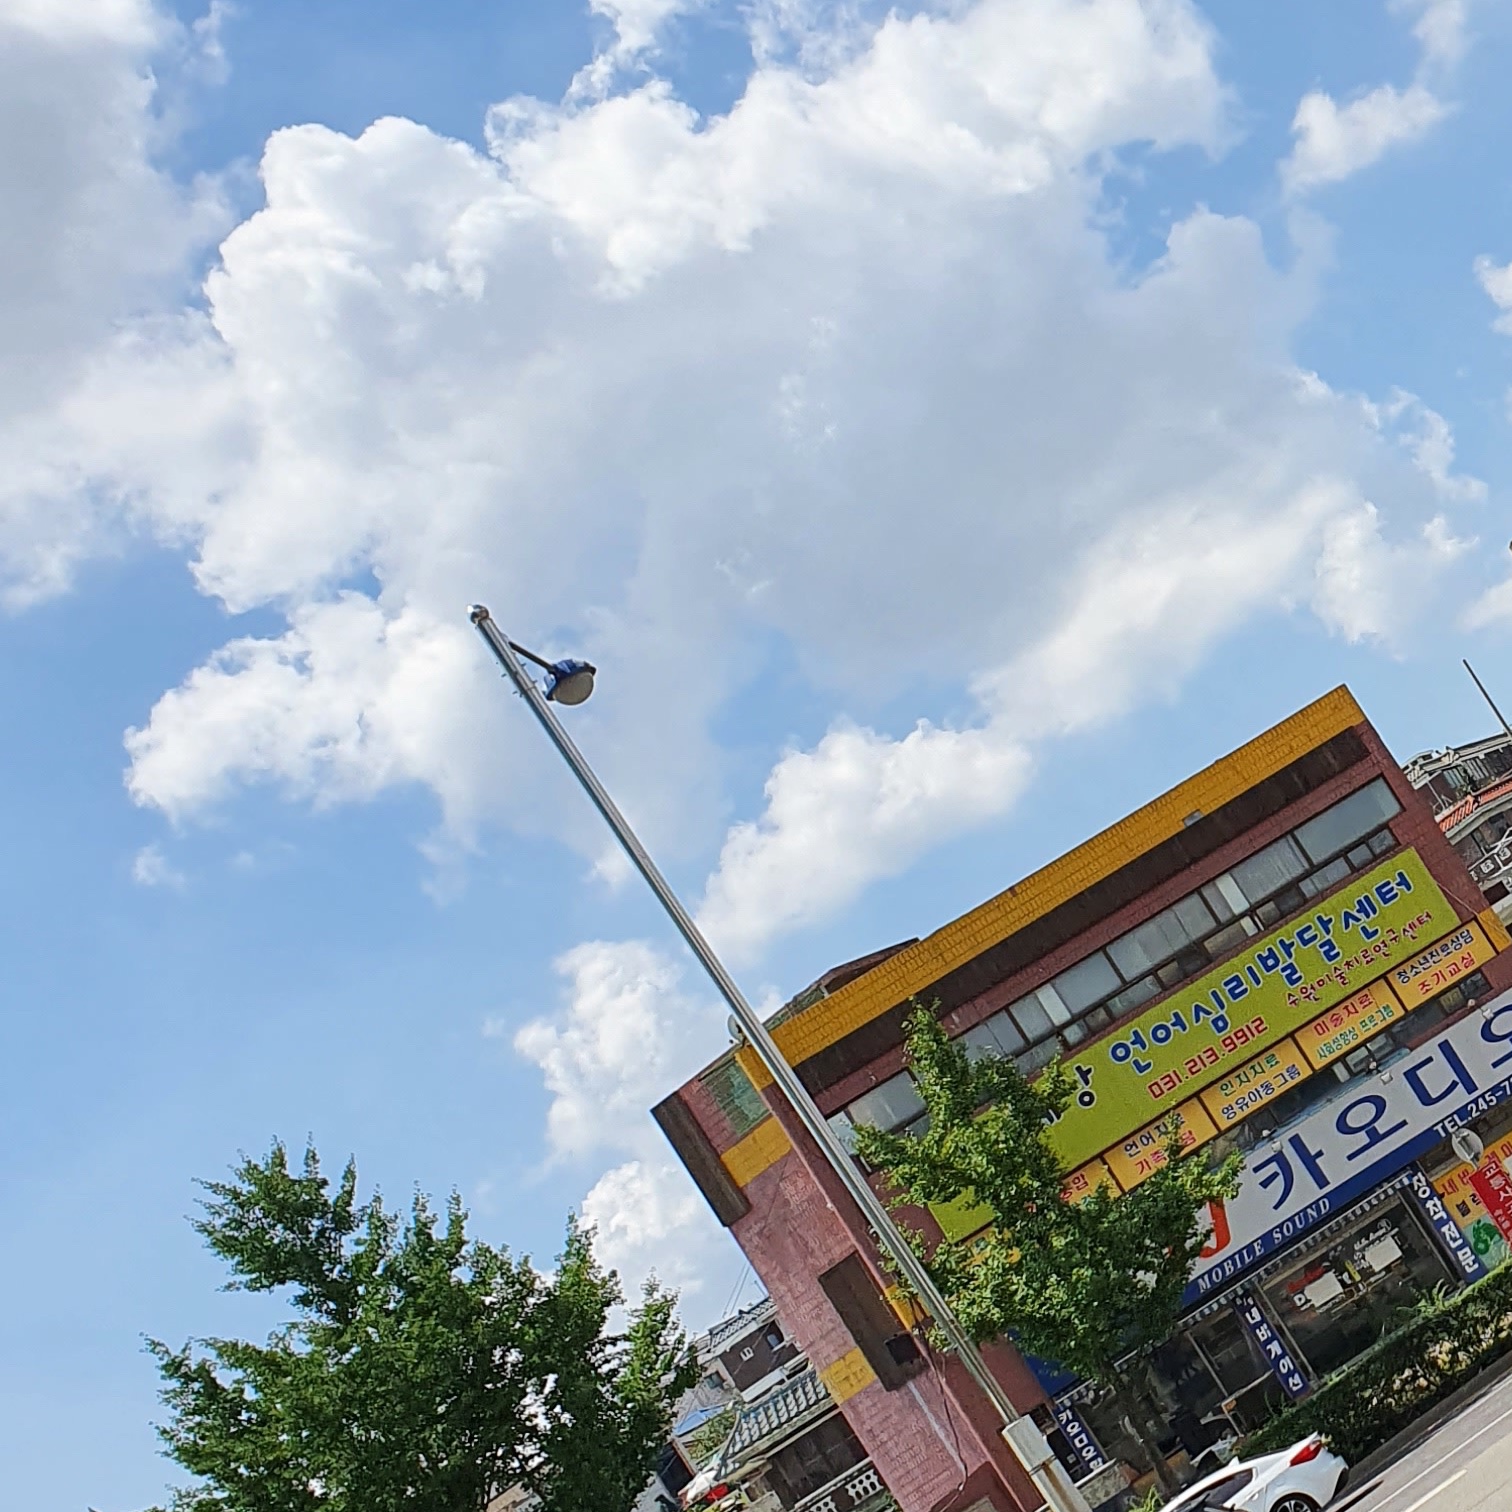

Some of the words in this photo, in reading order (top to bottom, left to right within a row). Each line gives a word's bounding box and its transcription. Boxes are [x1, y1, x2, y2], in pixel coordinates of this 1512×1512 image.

[1105, 865, 1427, 1087] 언어심리발달센터
[1395, 926, 1476, 986] 청소년진로상담
[1415, 950, 1476, 997] 조기교실
[1311, 991, 1375, 1039] 미술치료
[1145, 1014, 1270, 1100] 031.213.9912
[1218, 1050, 1280, 1098] 인지치료
[1219, 1061, 1304, 1123] 영유아동그룹
[1133, 1129, 1197, 1176] 가족담
[1193, 1237, 1267, 1295] MOBILE
[1268, 1194, 1334, 1245] SOUND
[1243, 1306, 1305, 1392] 네비게이션
